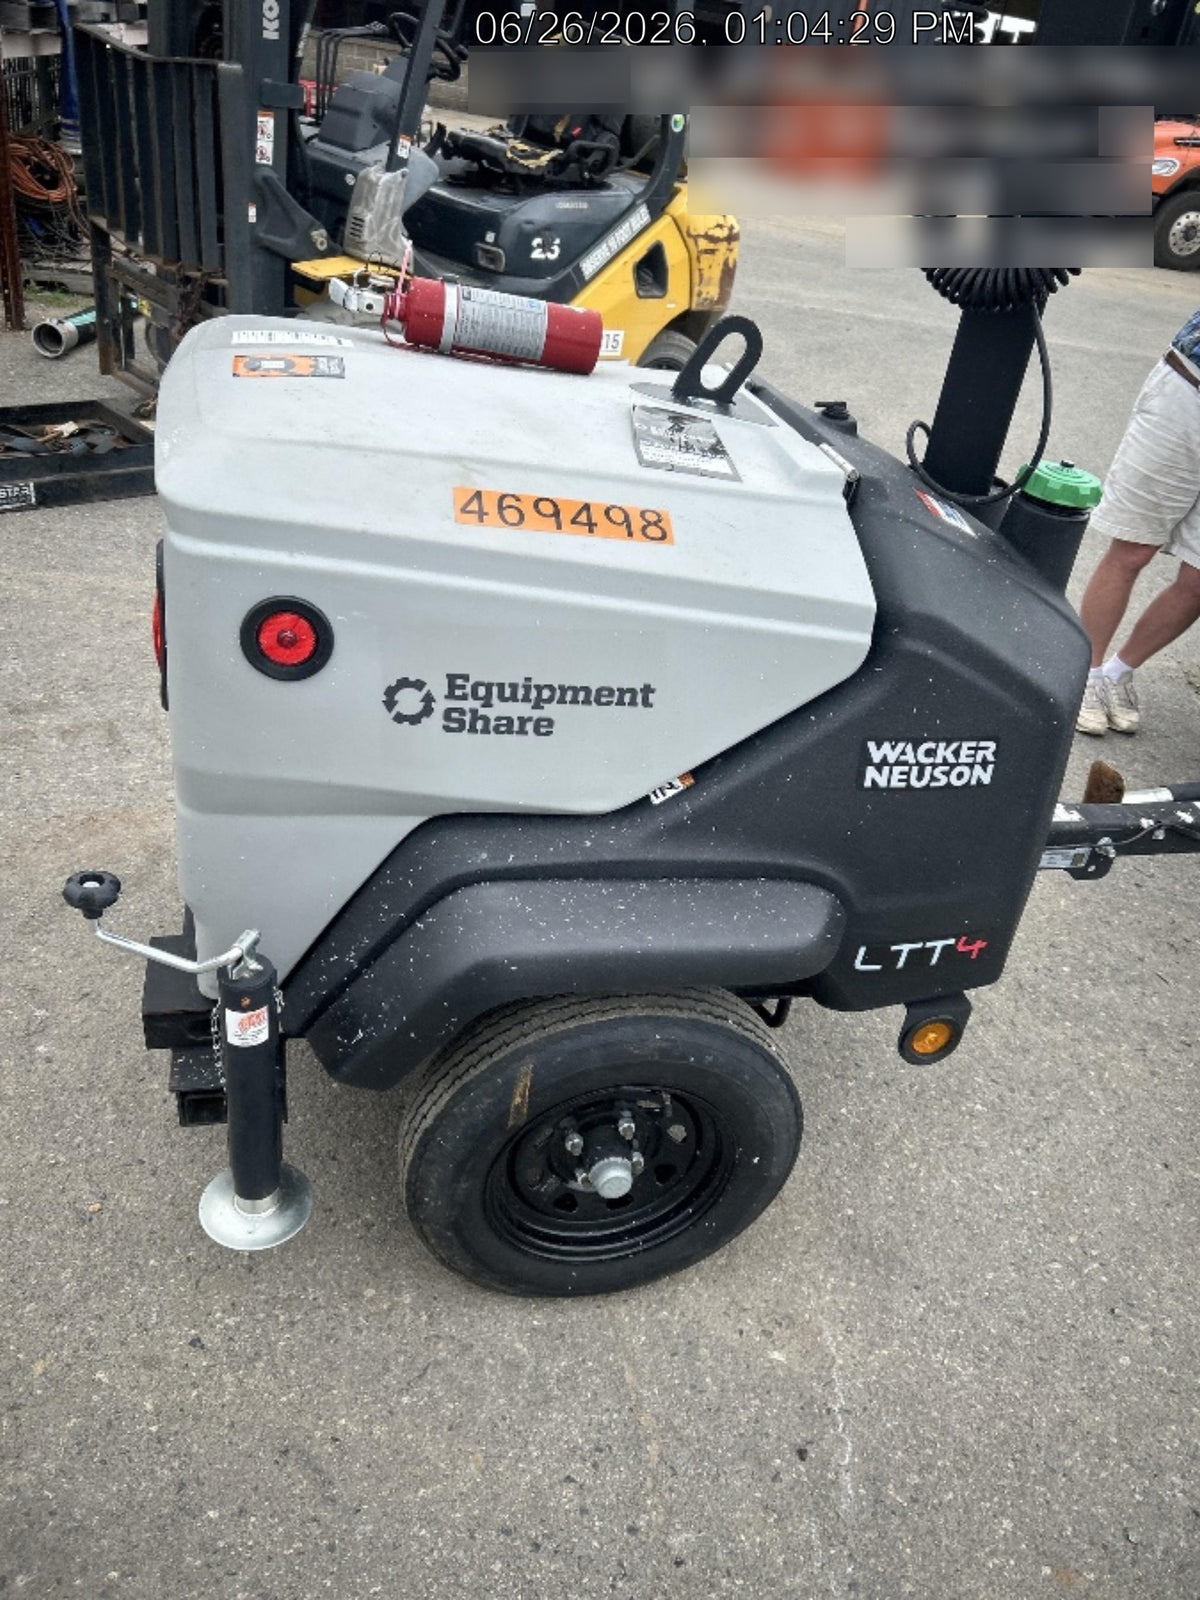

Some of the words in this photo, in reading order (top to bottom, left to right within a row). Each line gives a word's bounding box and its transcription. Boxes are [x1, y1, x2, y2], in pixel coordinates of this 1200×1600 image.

[460, 490, 667, 541] 469498
[444, 673, 656, 709] Equipment
[442, 707, 555, 736] Share
[867, 741, 997, 764] WACKER
[864, 764, 994, 788] NEUSON
[854, 935, 988, 971] LTT4
